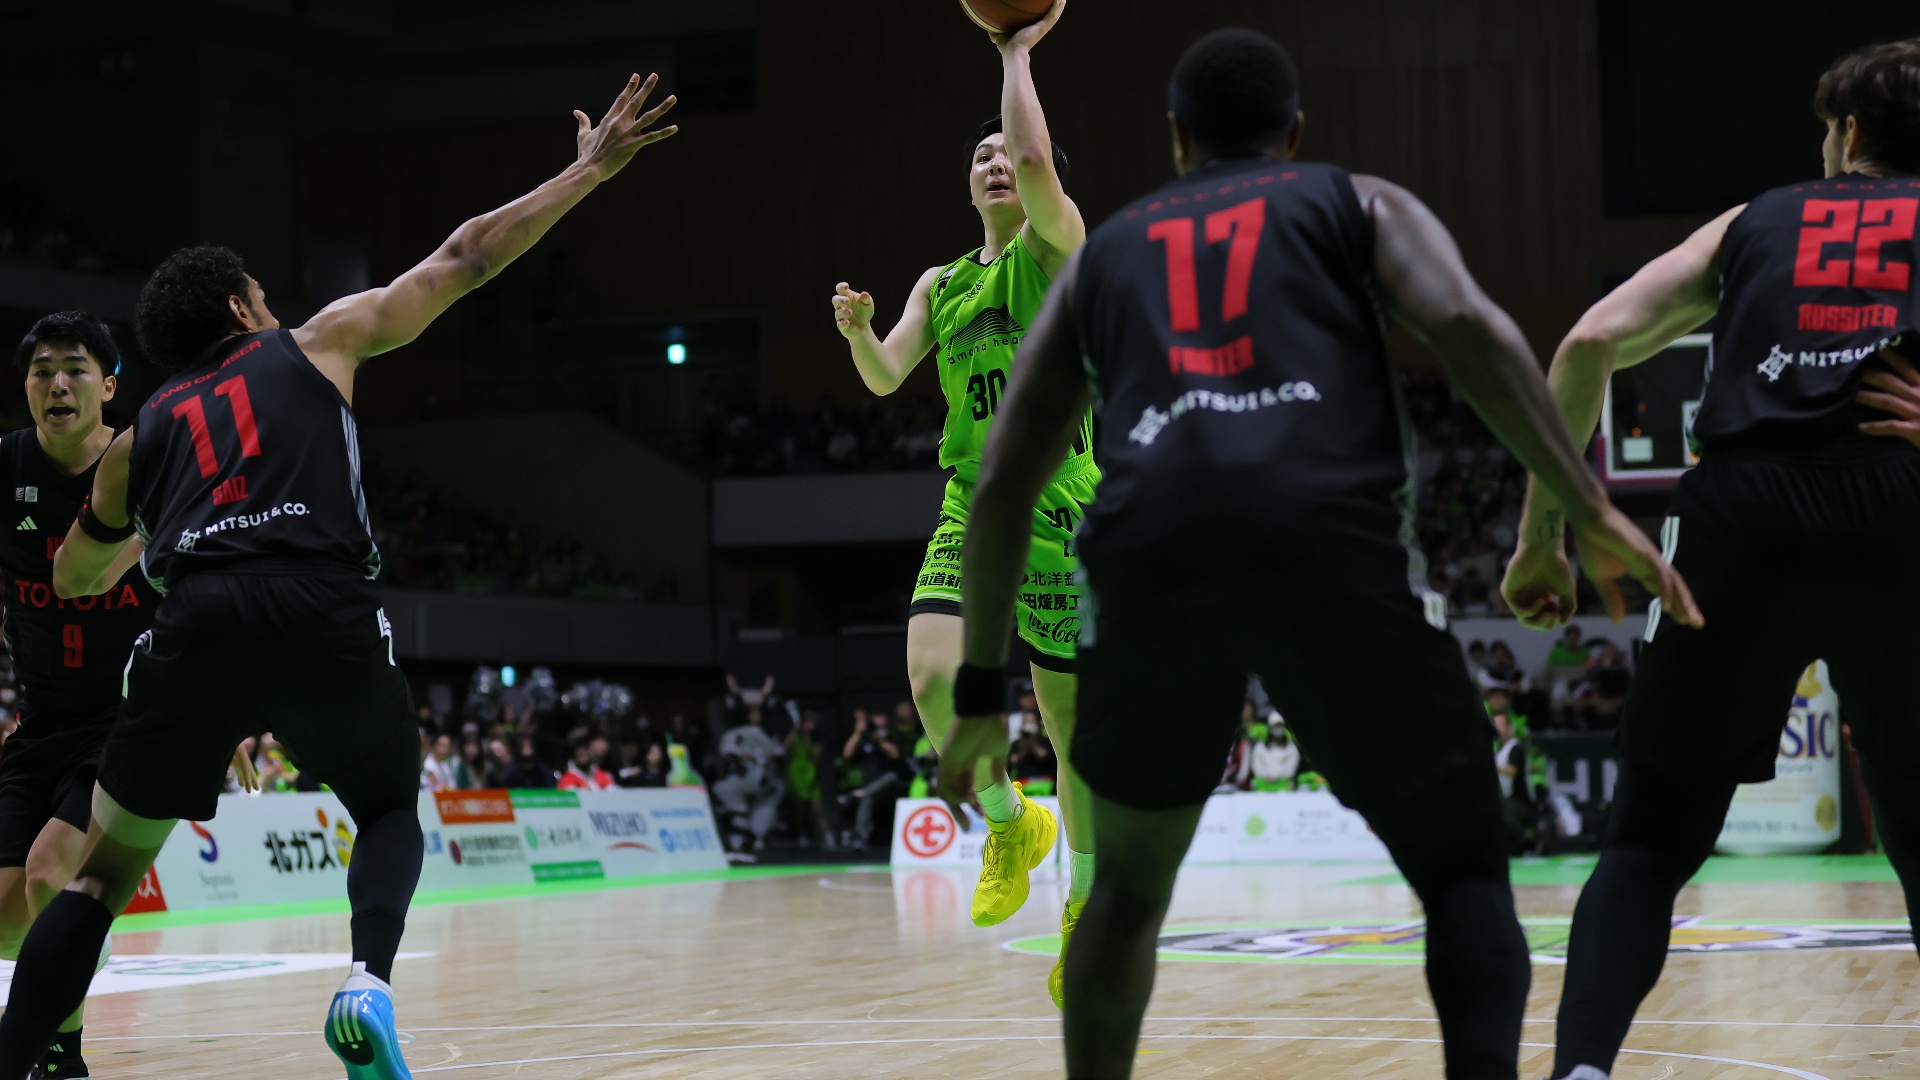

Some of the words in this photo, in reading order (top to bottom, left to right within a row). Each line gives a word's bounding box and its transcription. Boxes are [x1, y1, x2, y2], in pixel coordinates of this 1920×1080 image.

[1147, 197, 1266, 334] 17
[1793, 197, 1920, 291] 22
[1798, 303, 1898, 332] ROSSITER
[151, 381, 191, 408] LAND
[967, 368, 1007, 421] 30
[172, 374, 261, 480] 11
[212, 476, 249, 506] SAIZ
[15, 579, 140, 611] TOOTA
[62, 623, 84, 668] 9
[264, 830, 337, 874] 北ガス
